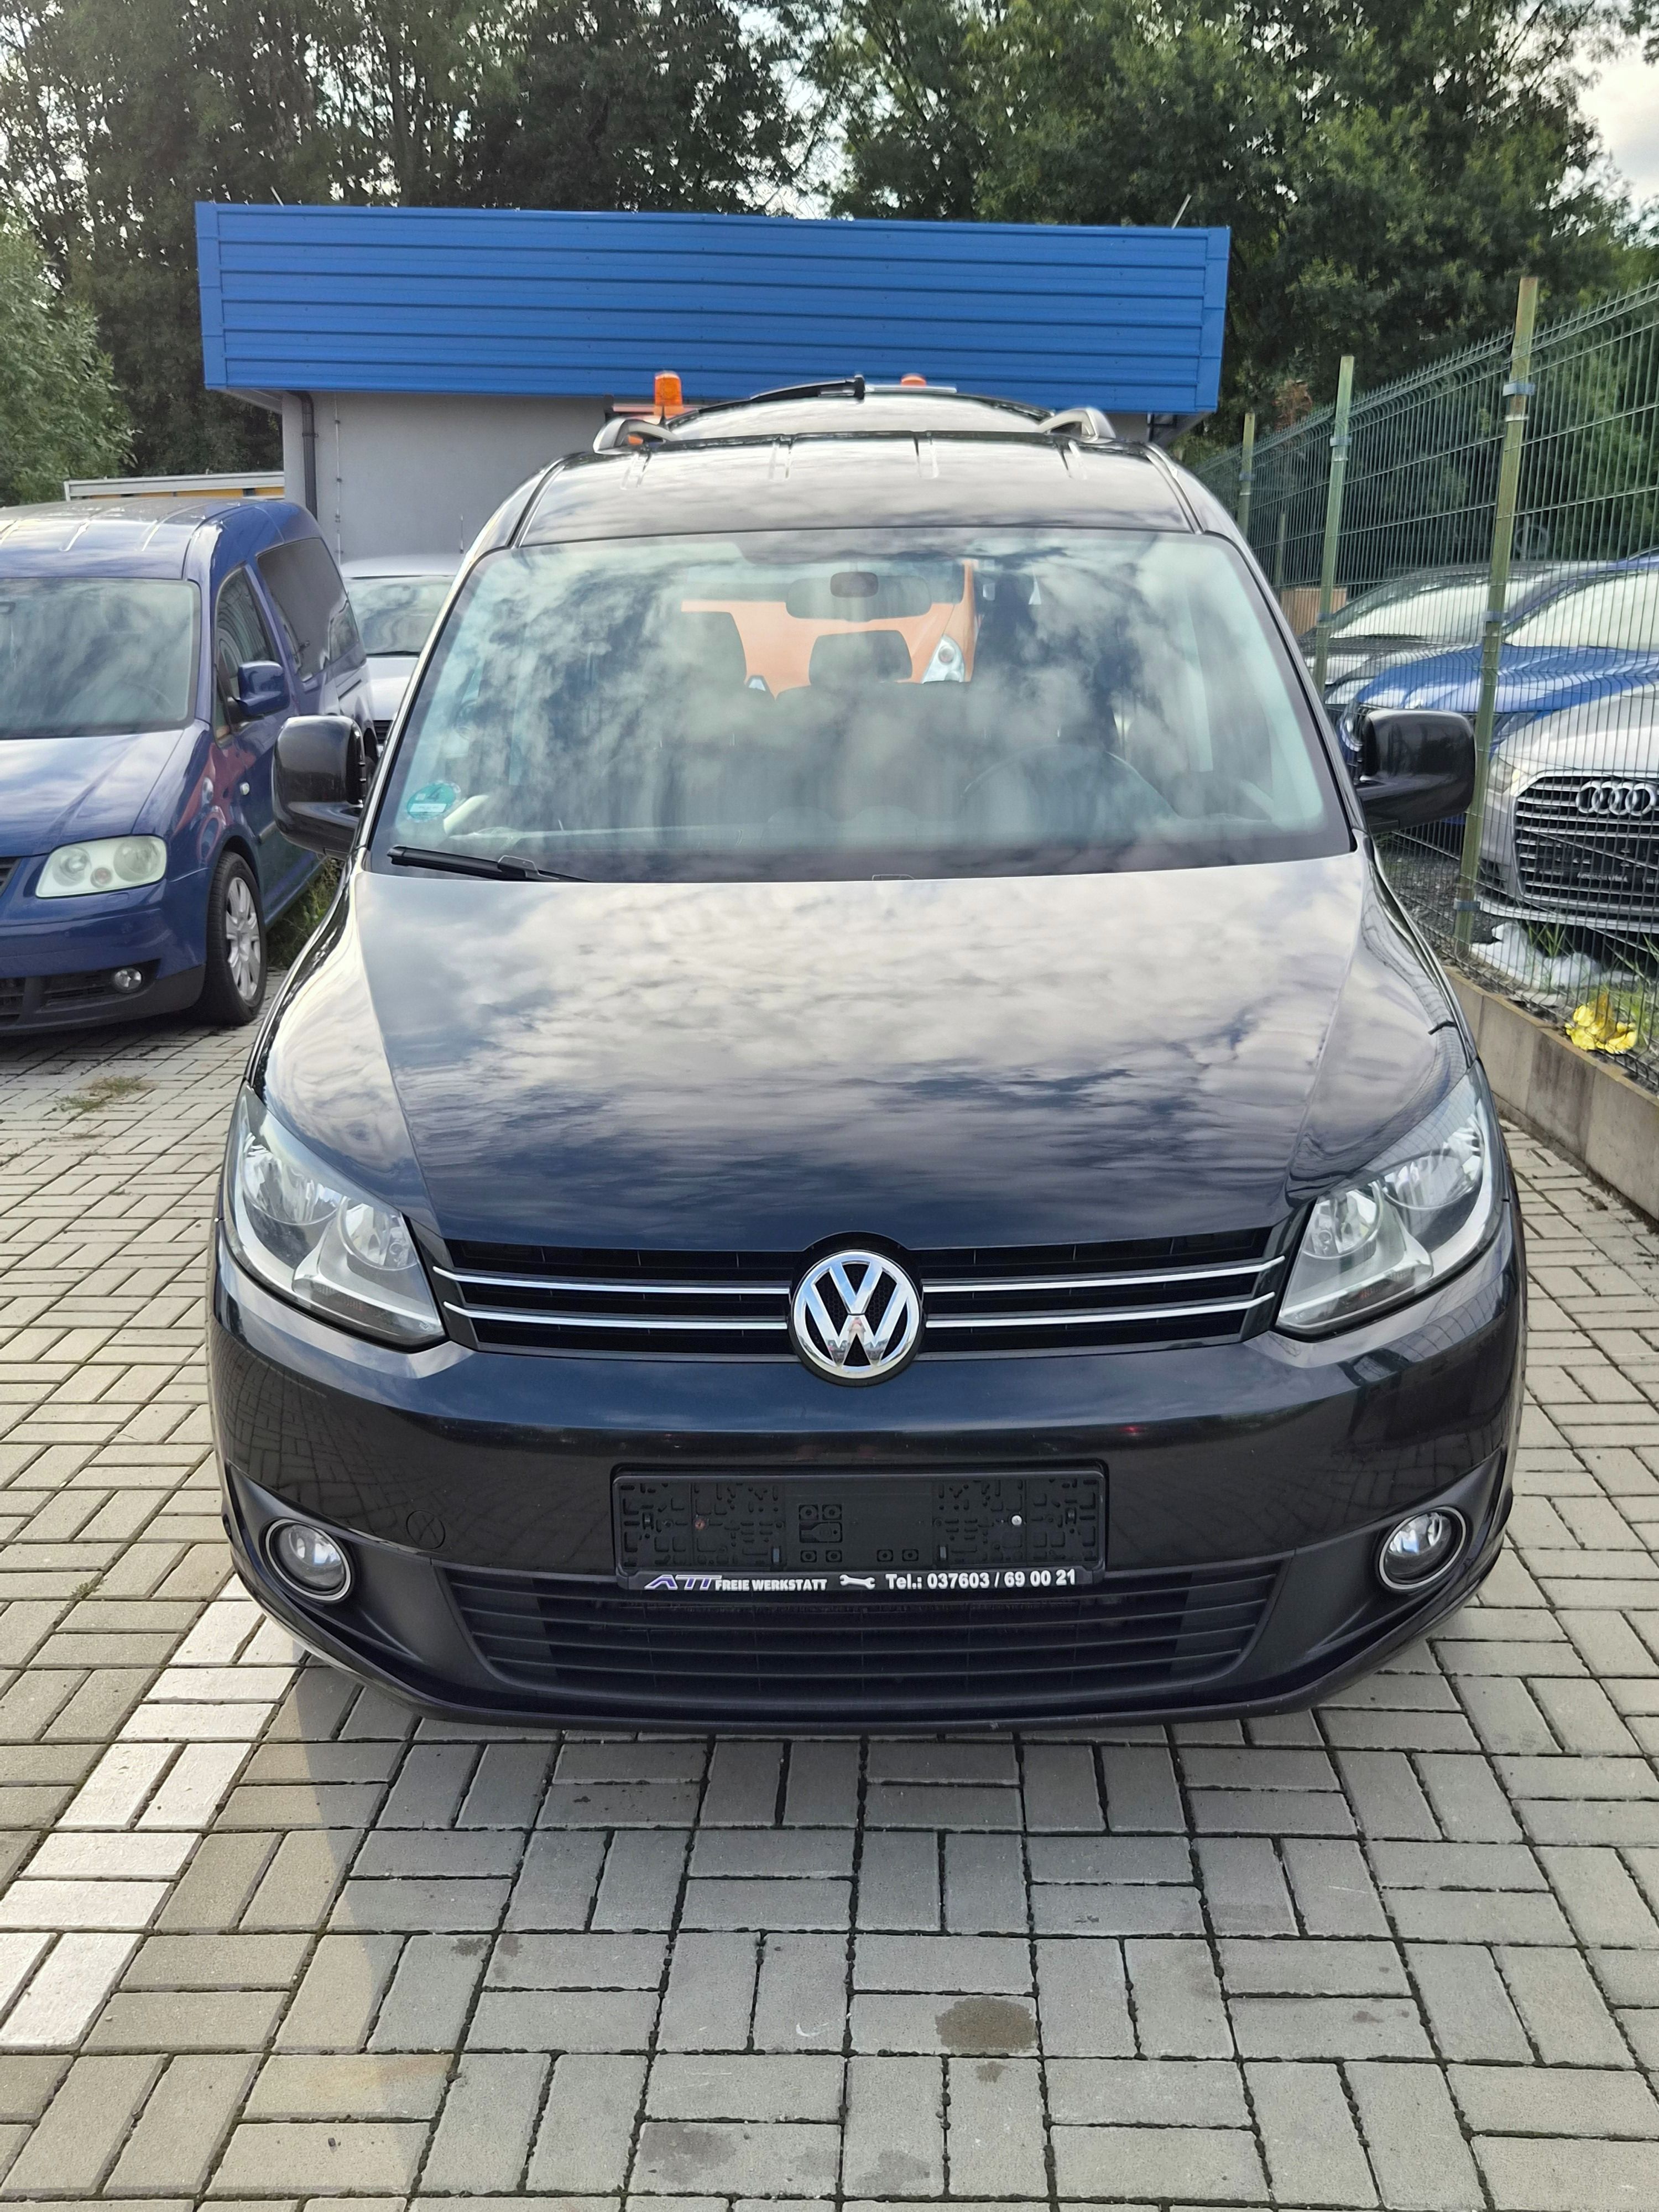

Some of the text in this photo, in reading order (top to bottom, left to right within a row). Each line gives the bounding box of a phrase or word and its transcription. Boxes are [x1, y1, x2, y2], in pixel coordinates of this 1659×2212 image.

[715, 1579, 750, 1592] FREIE
[752, 1579, 827, 1592] WERKSTATT
[885, 1573, 922, 1589] Tel.:
[927, 1572, 990, 1589] 037603
[1004, 1571, 1025, 1588] 69
[1030, 1570, 1051, 1587] 00
[1056, 1569, 1076, 1586] 21
